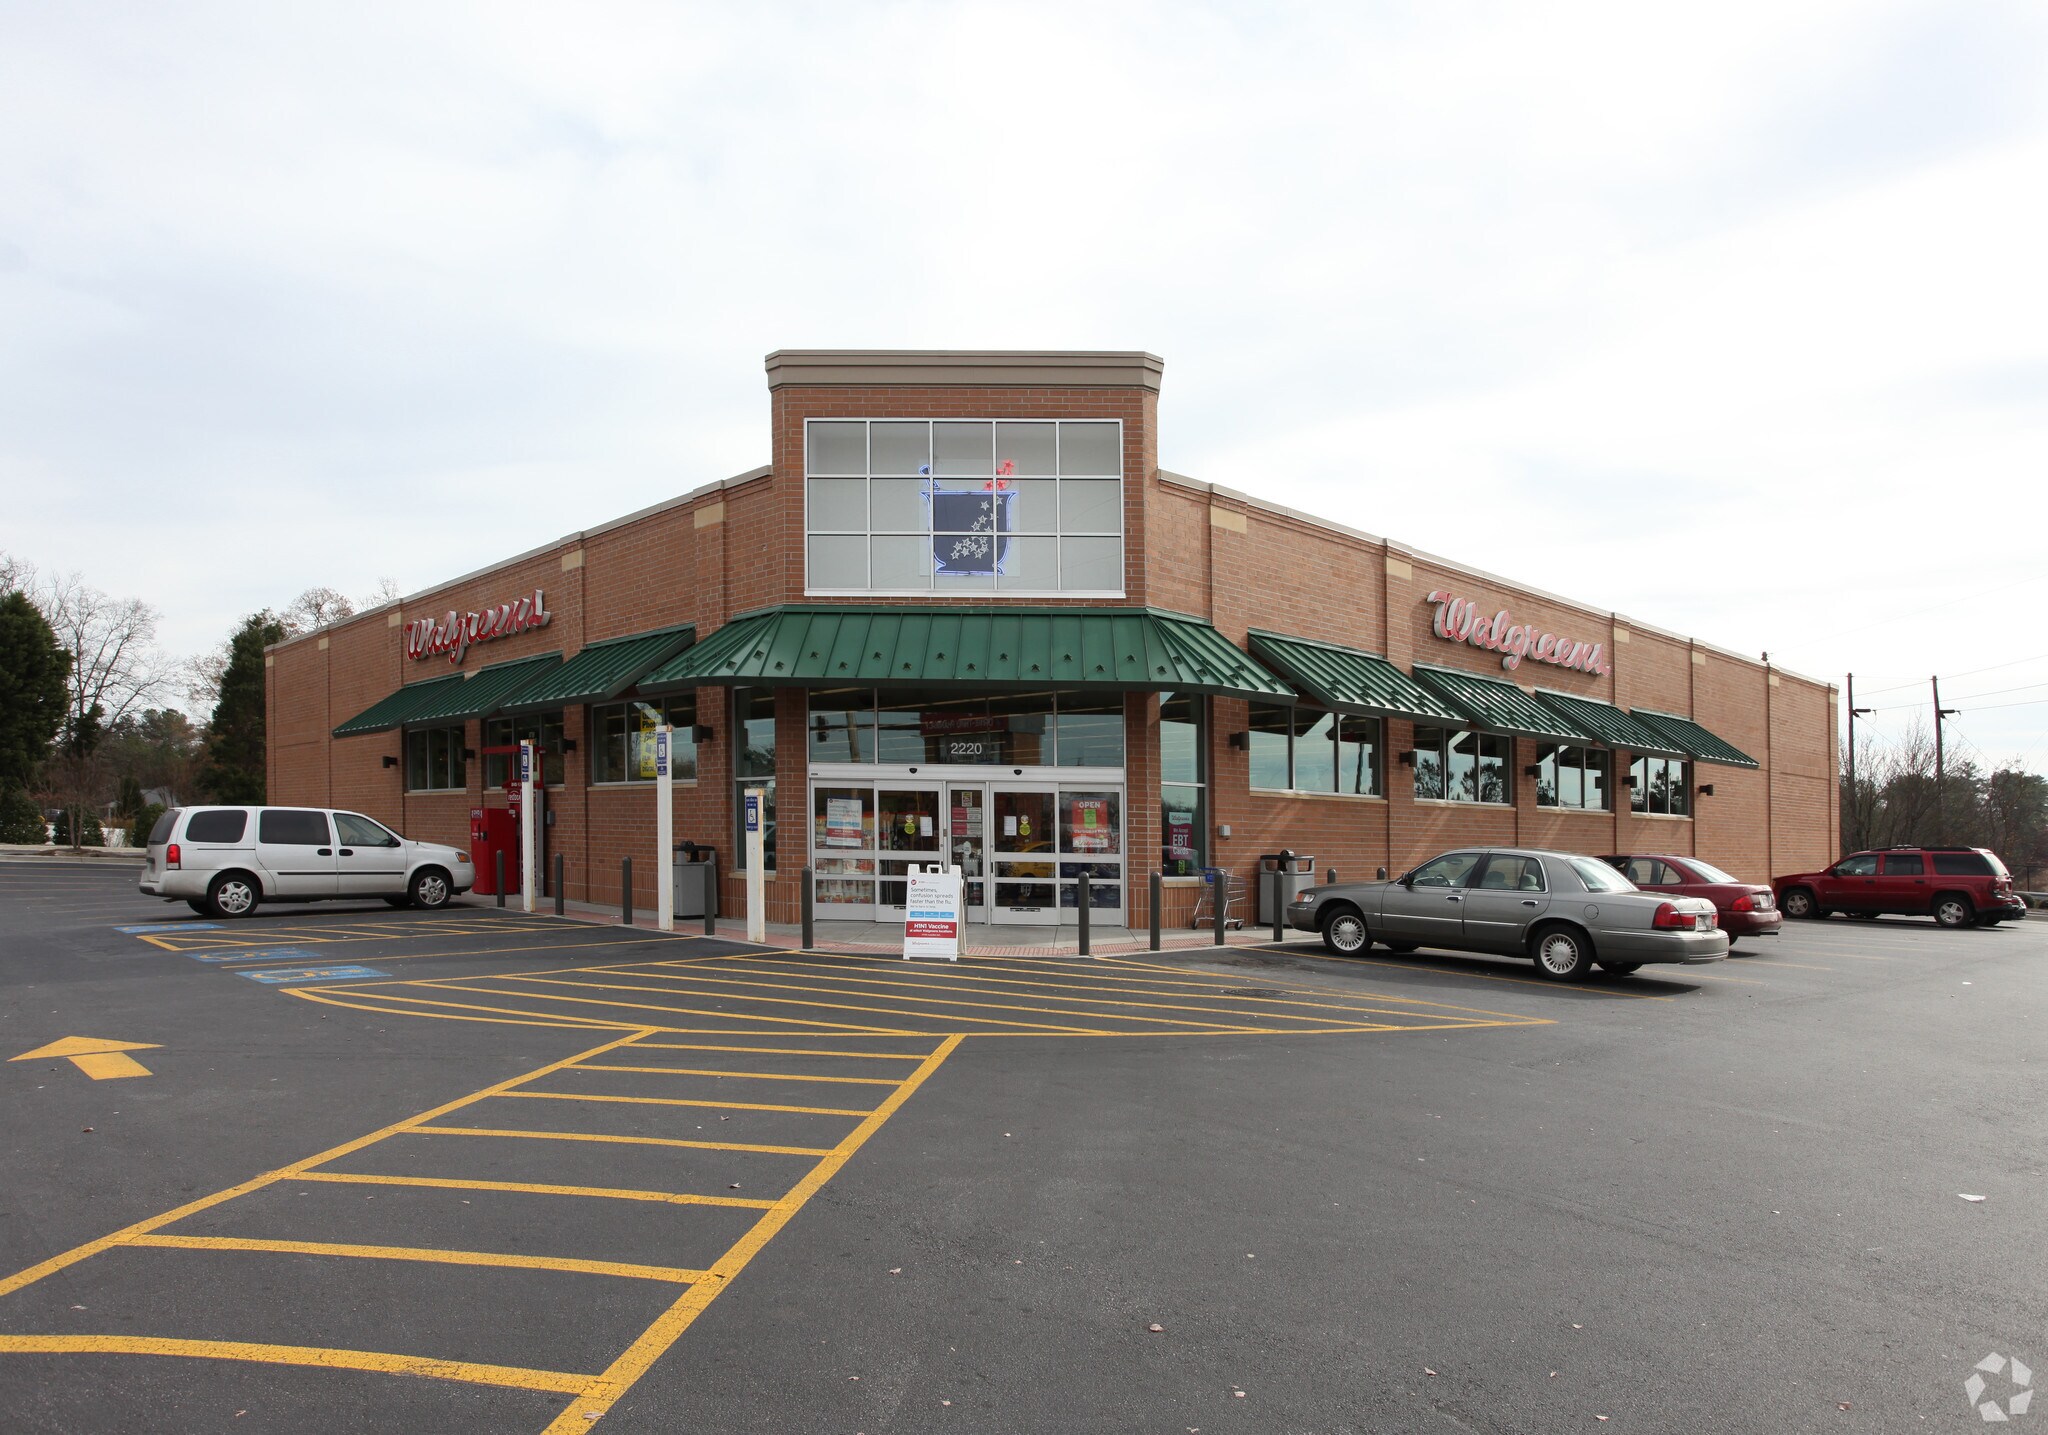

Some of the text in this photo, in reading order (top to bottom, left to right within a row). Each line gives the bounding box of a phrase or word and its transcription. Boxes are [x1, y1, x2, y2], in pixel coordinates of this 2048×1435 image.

[404, 589, 550, 664] Walgreens
[1427, 590, 1612, 677] Walgreens
[950, 742, 982, 755] 2220
[1079, 801, 1101, 809] OPEN
[1172, 834, 1189, 847] EBT
